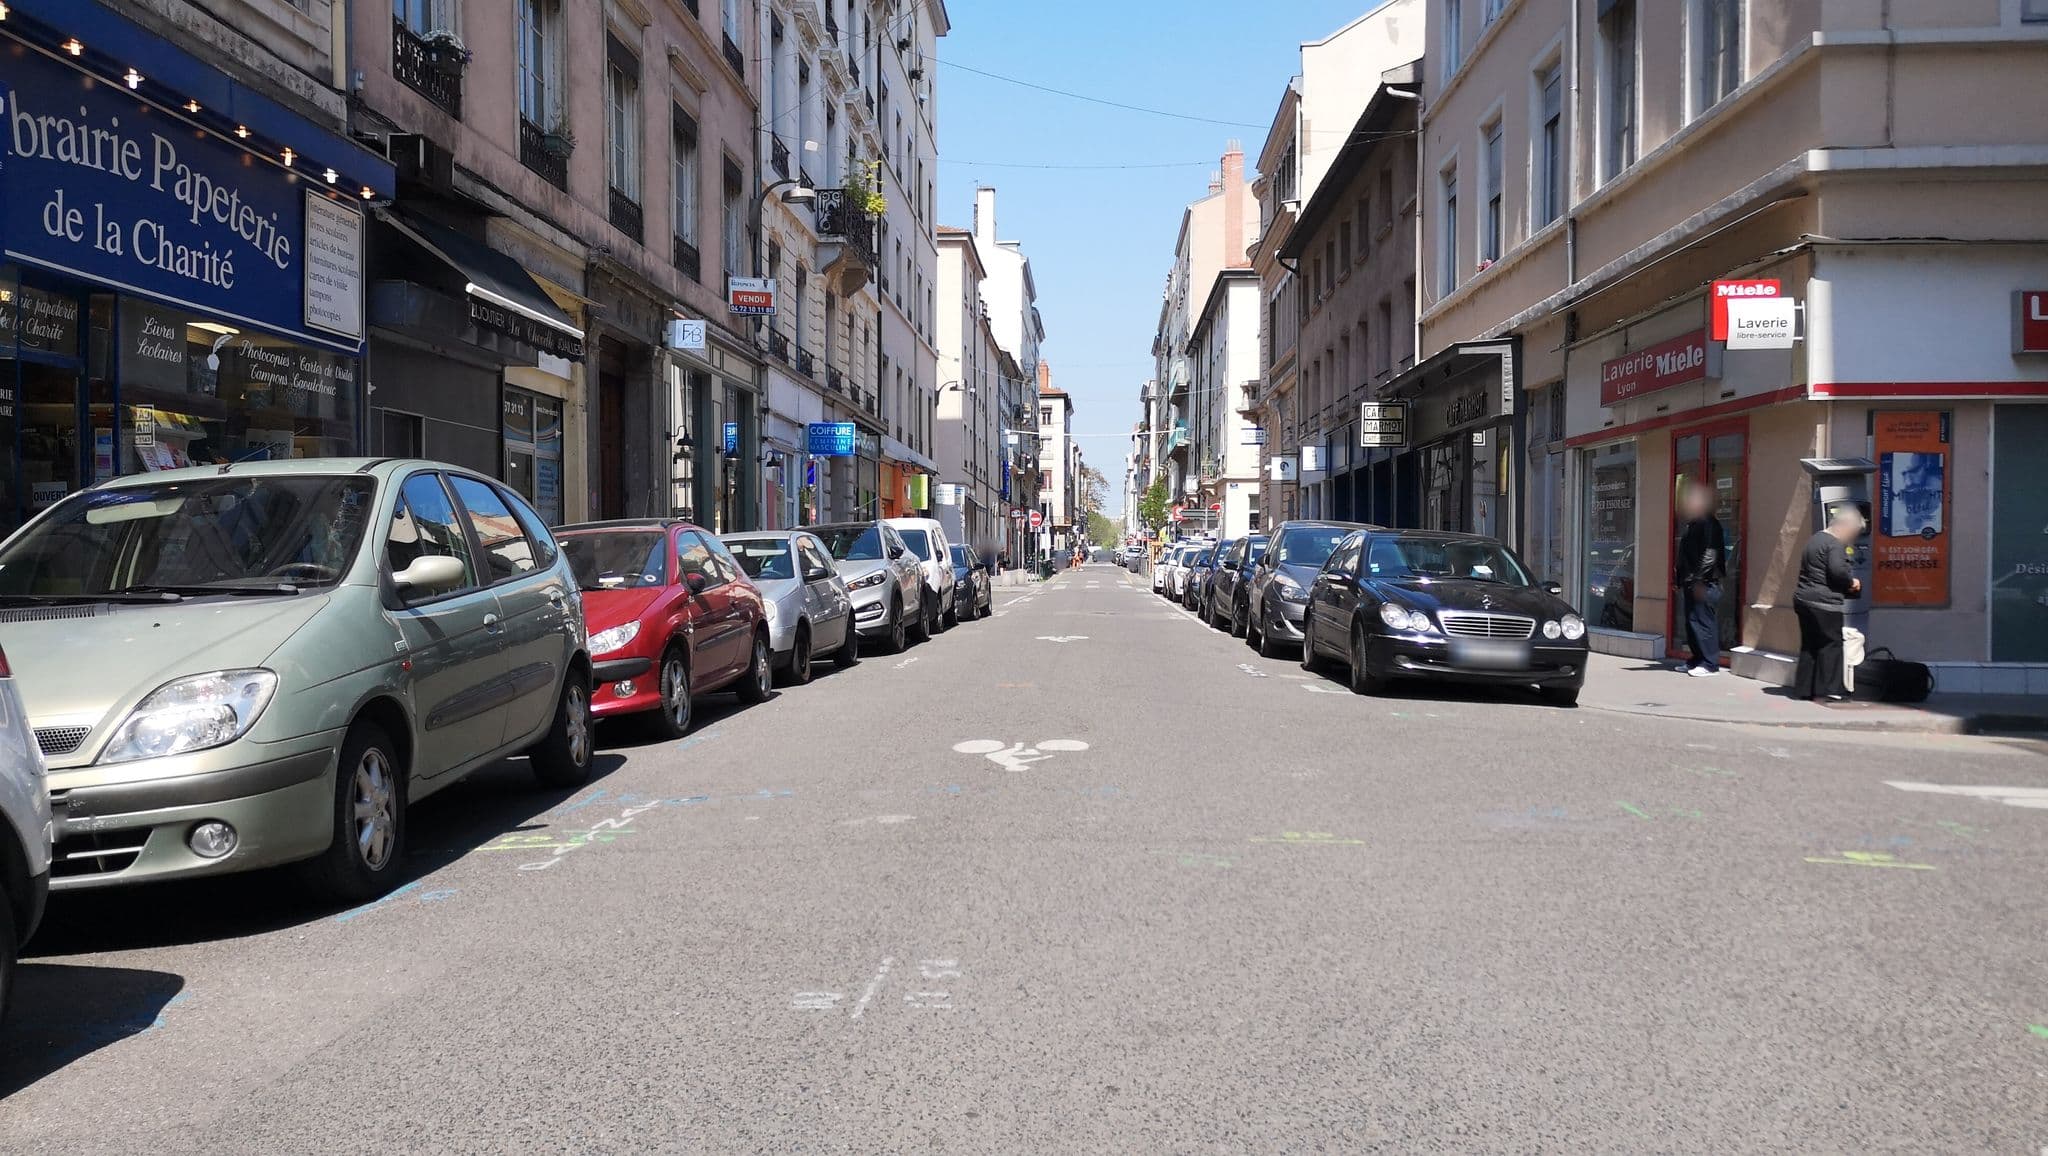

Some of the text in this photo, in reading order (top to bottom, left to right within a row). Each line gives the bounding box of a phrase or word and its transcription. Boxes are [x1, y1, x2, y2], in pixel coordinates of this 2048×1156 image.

[8, 90, 290, 269] brairie Papeterie
[44, 189, 234, 289] de la Charité
[738, 294, 766, 304] VENDU
[1717, 284, 1777, 296] Miele
[26, 317, 64, 340] Charité
[142, 316, 175, 340] Livres
[1737, 316, 1788, 329] Laverie
[1737, 331, 1787, 339] libre-service
[137, 337, 182, 363] Scolaires
[240, 340, 290, 367] Photocopies
[1603, 345, 1704, 383] Laverie Miele
[250, 363, 336, 396] Tampons Caoutchouc
[1617, 381, 1636, 396] Lyon
[810, 426, 852, 435] COIFFURE
[1365, 421, 1403, 432] MARMOT
